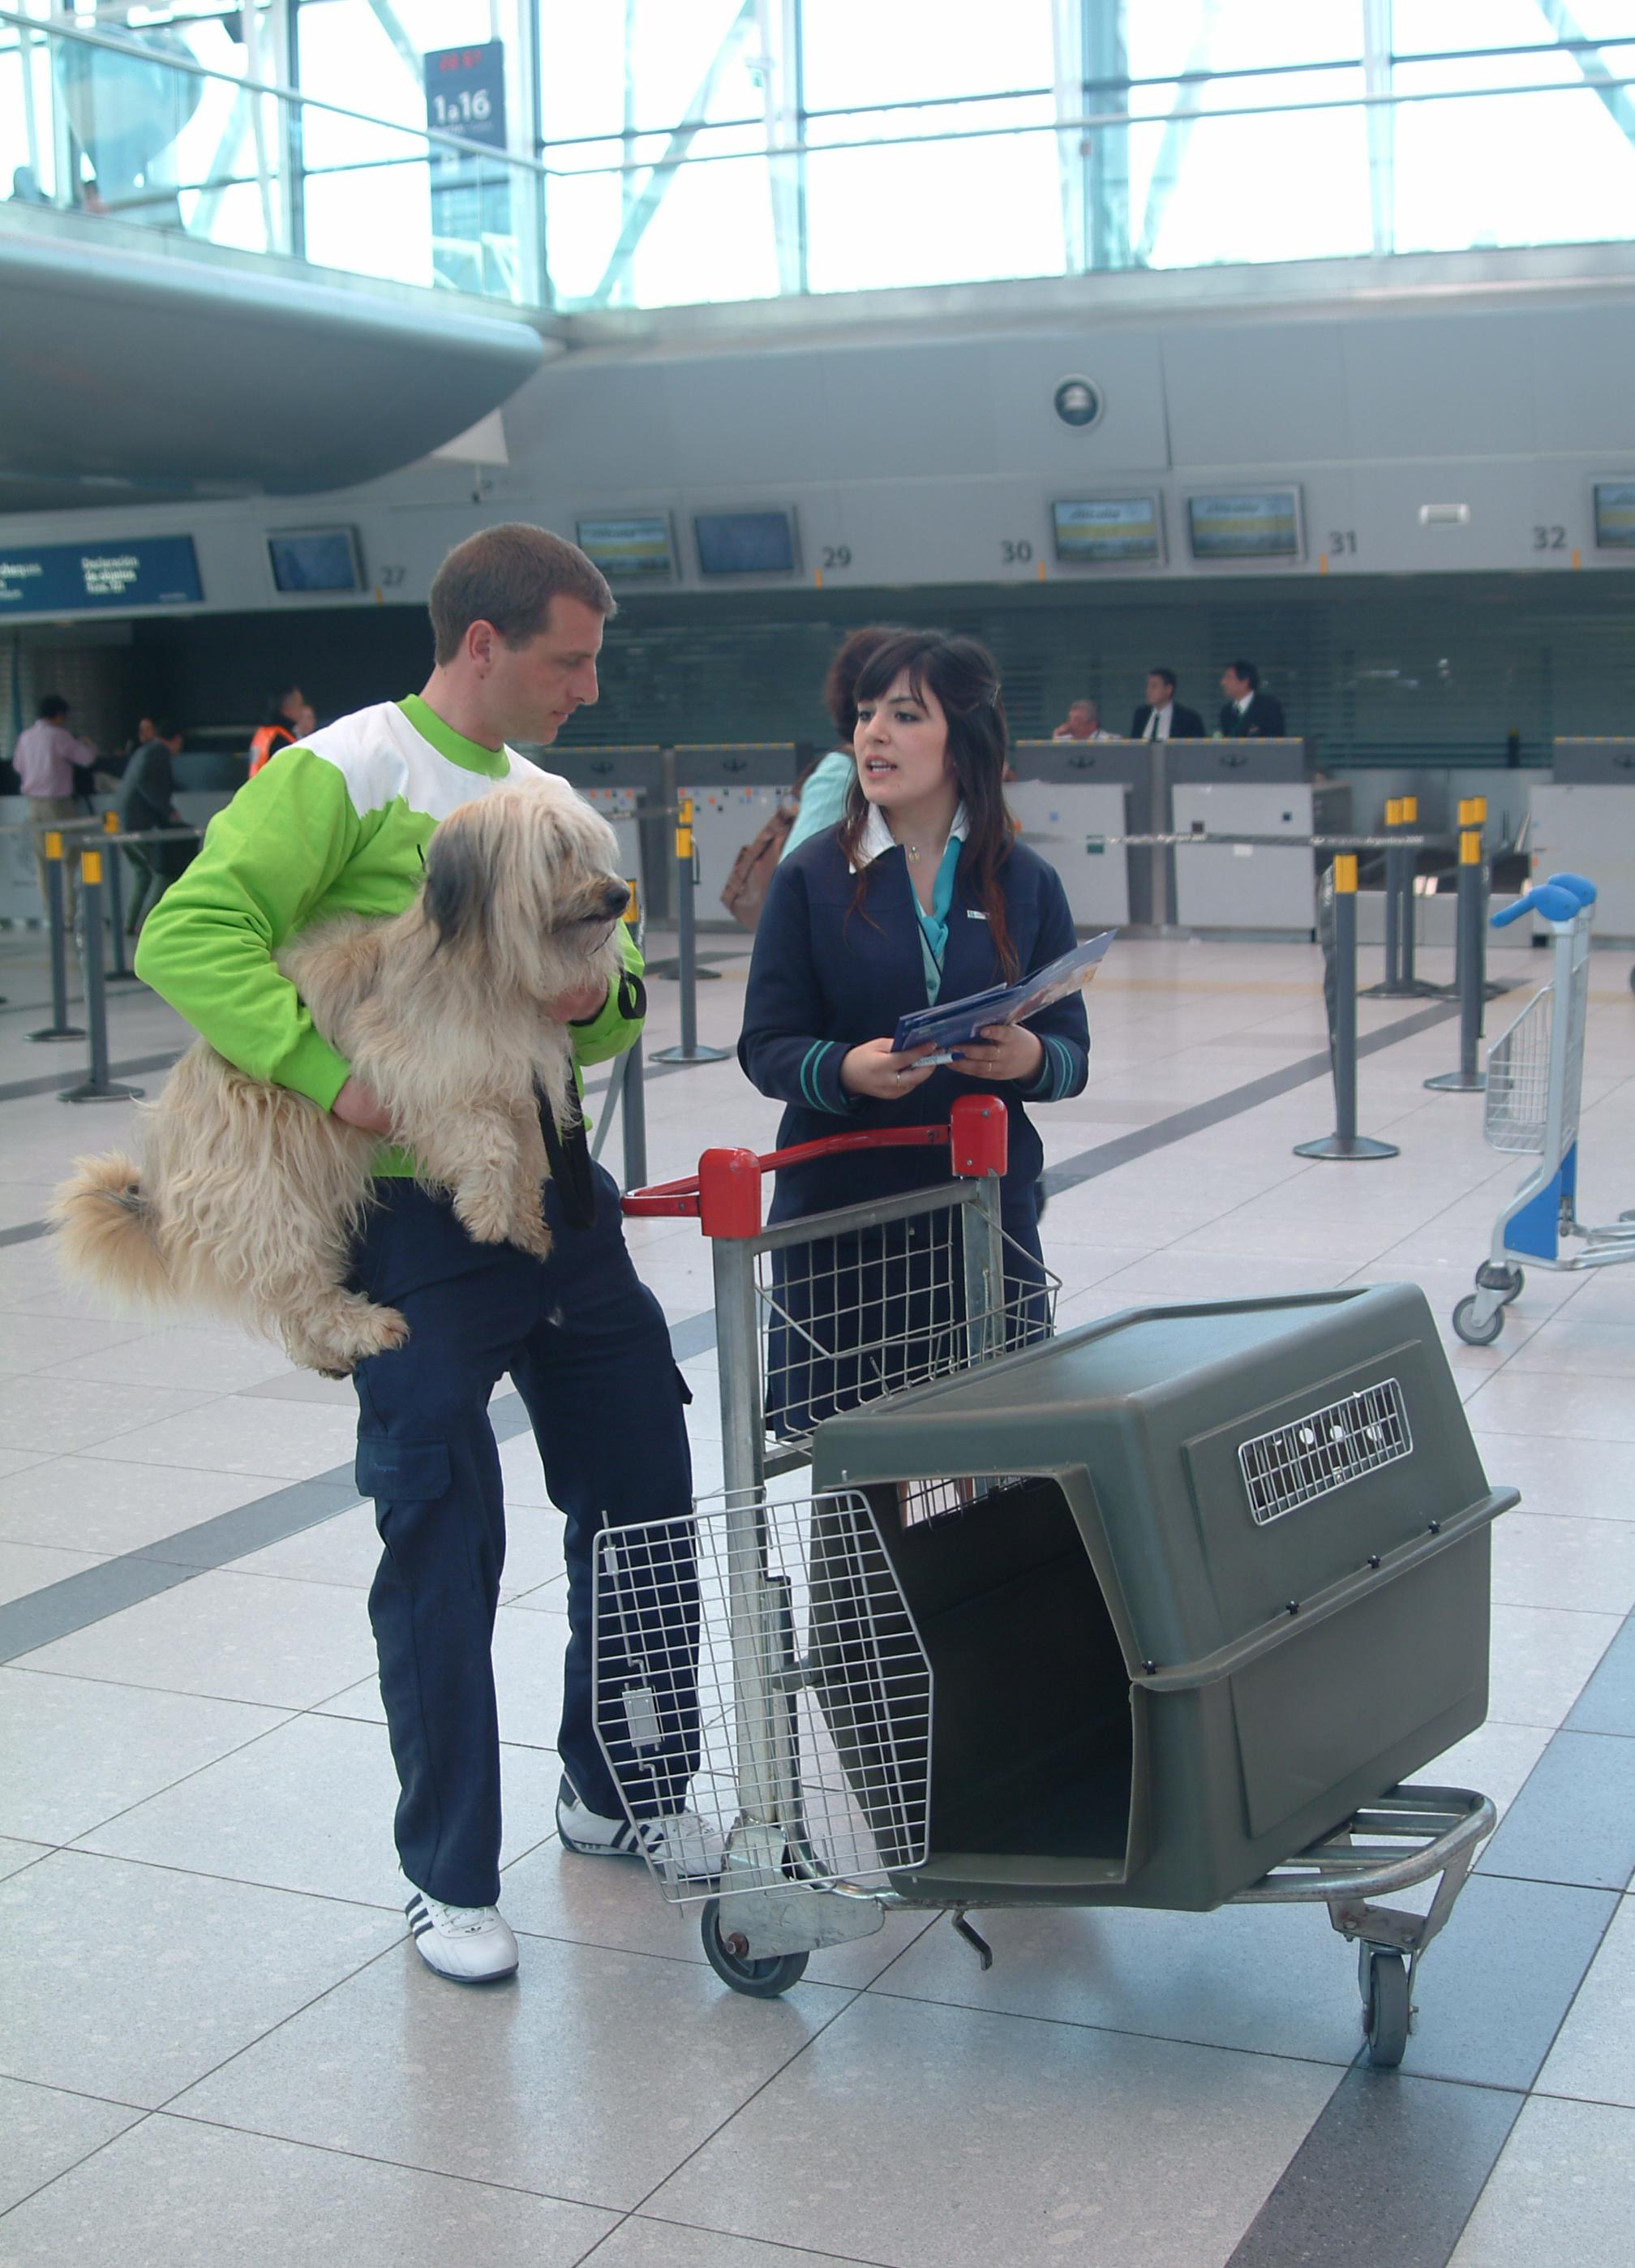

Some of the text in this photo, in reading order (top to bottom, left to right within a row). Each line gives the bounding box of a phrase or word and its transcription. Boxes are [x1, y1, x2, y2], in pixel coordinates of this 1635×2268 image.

[1330, 530, 1357, 554] 31
[1534, 525, 1567, 549] 32
[822, 545, 852, 568] 29
[1002, 540, 1032, 561] 30
